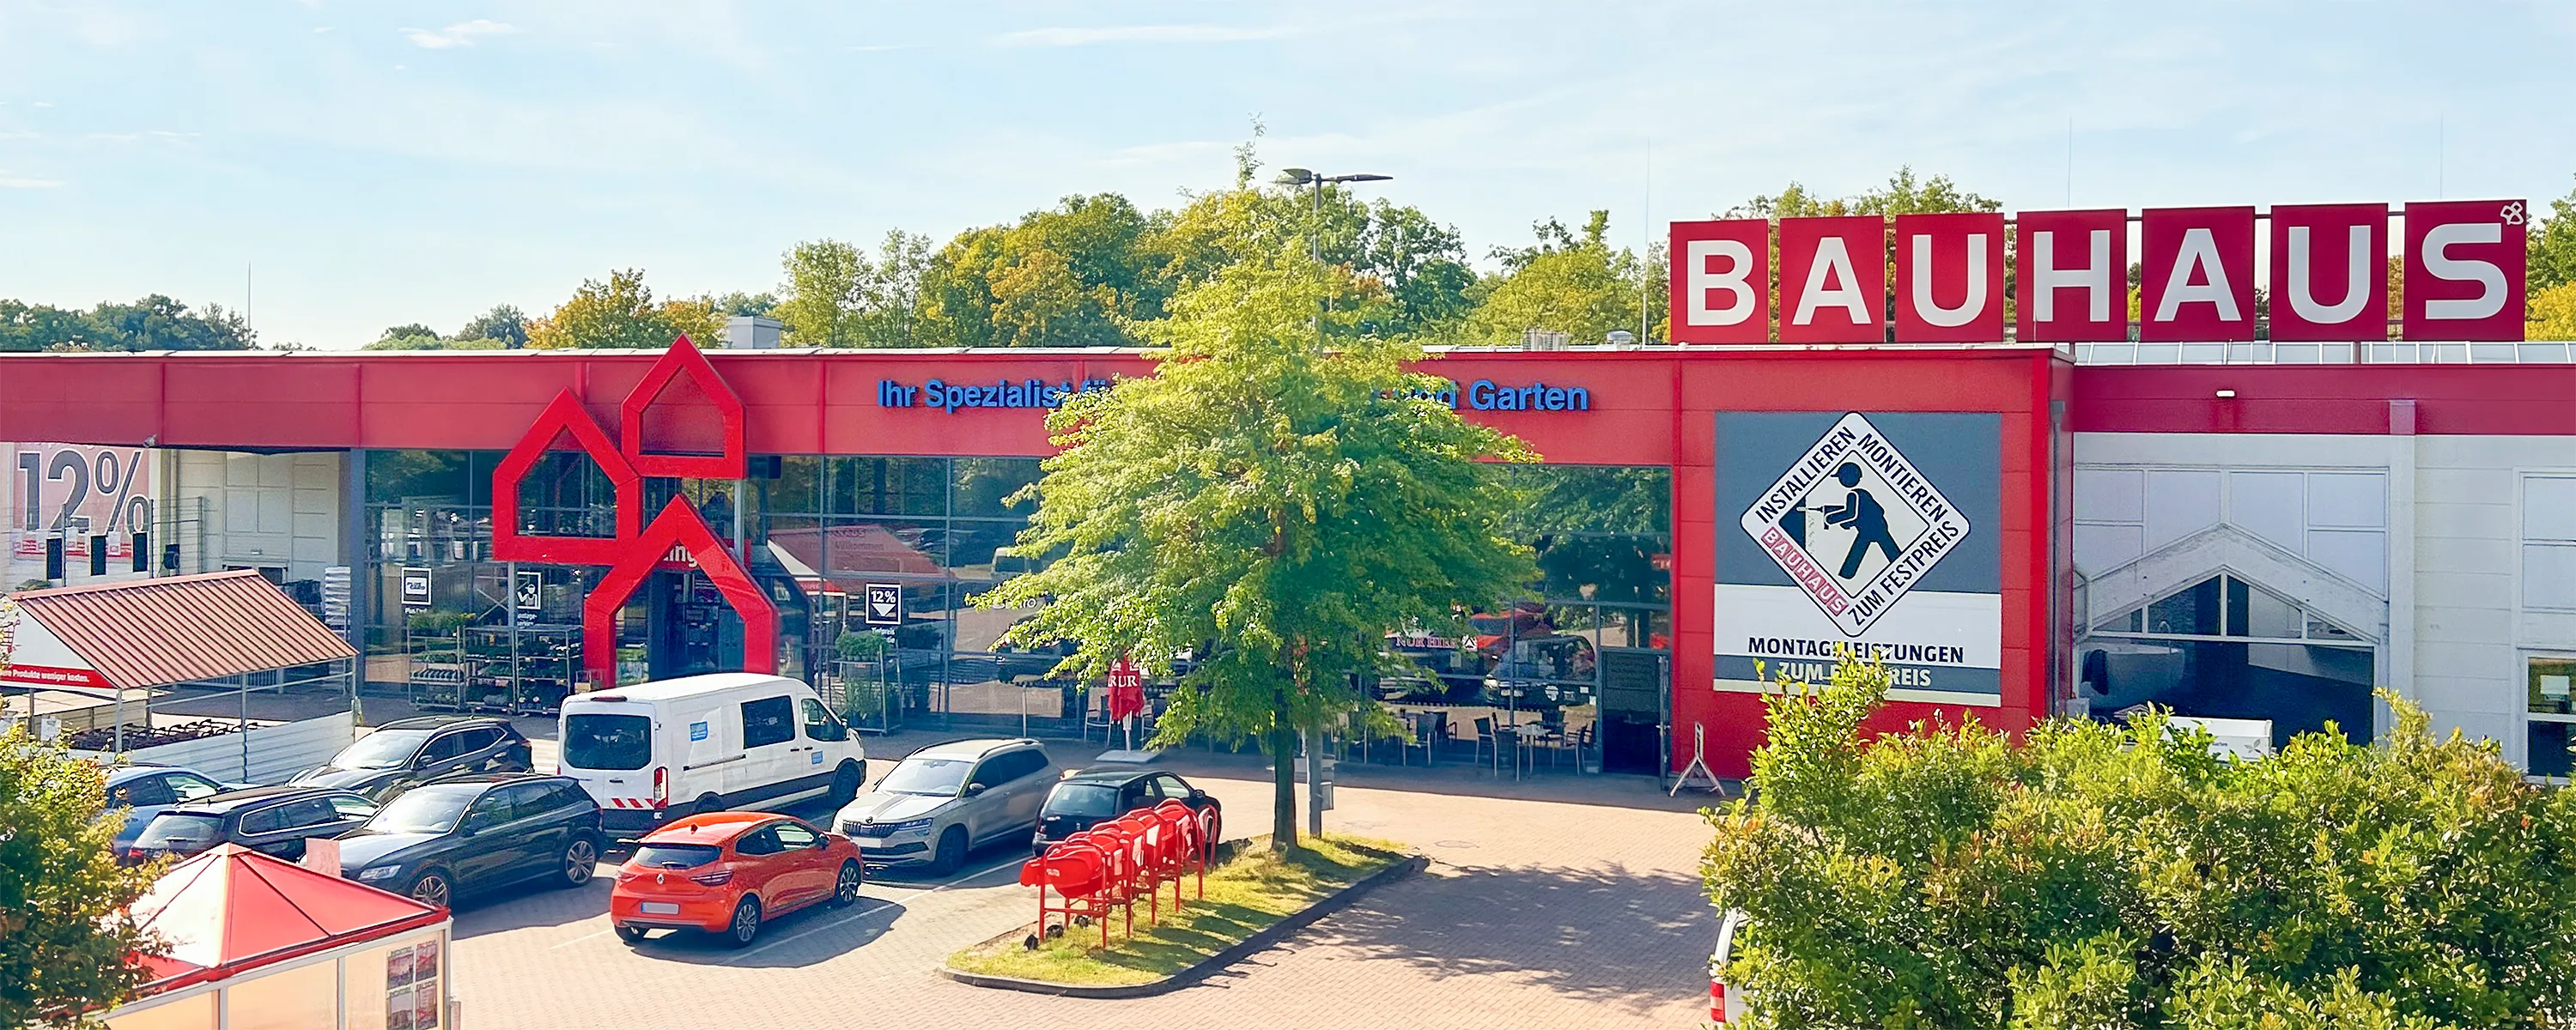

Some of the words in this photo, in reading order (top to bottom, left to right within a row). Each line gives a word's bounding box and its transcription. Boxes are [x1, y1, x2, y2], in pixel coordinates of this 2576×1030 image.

[1685, 222, 2508, 327] BAUHAUS
[877, 380, 915, 409] Ihr
[1469, 379, 1589, 411] Garten
[17, 448, 150, 536] 12%
[1755, 426, 1856, 524] INSTALLIEREN
[1857, 433, 1948, 523] MONTIEREN
[871, 590, 896, 603] 12%
[1761, 526, 1849, 616] BAUHAUS
[1848, 590, 1886, 627] ZUM
[1883, 520, 1959, 596] FESTPREIS
[1748, 637, 1965, 663] MONTAGEISTUNGEN
[1778, 662, 1824, 682] ZUM
[1831, 663, 1932, 687] FREIS
